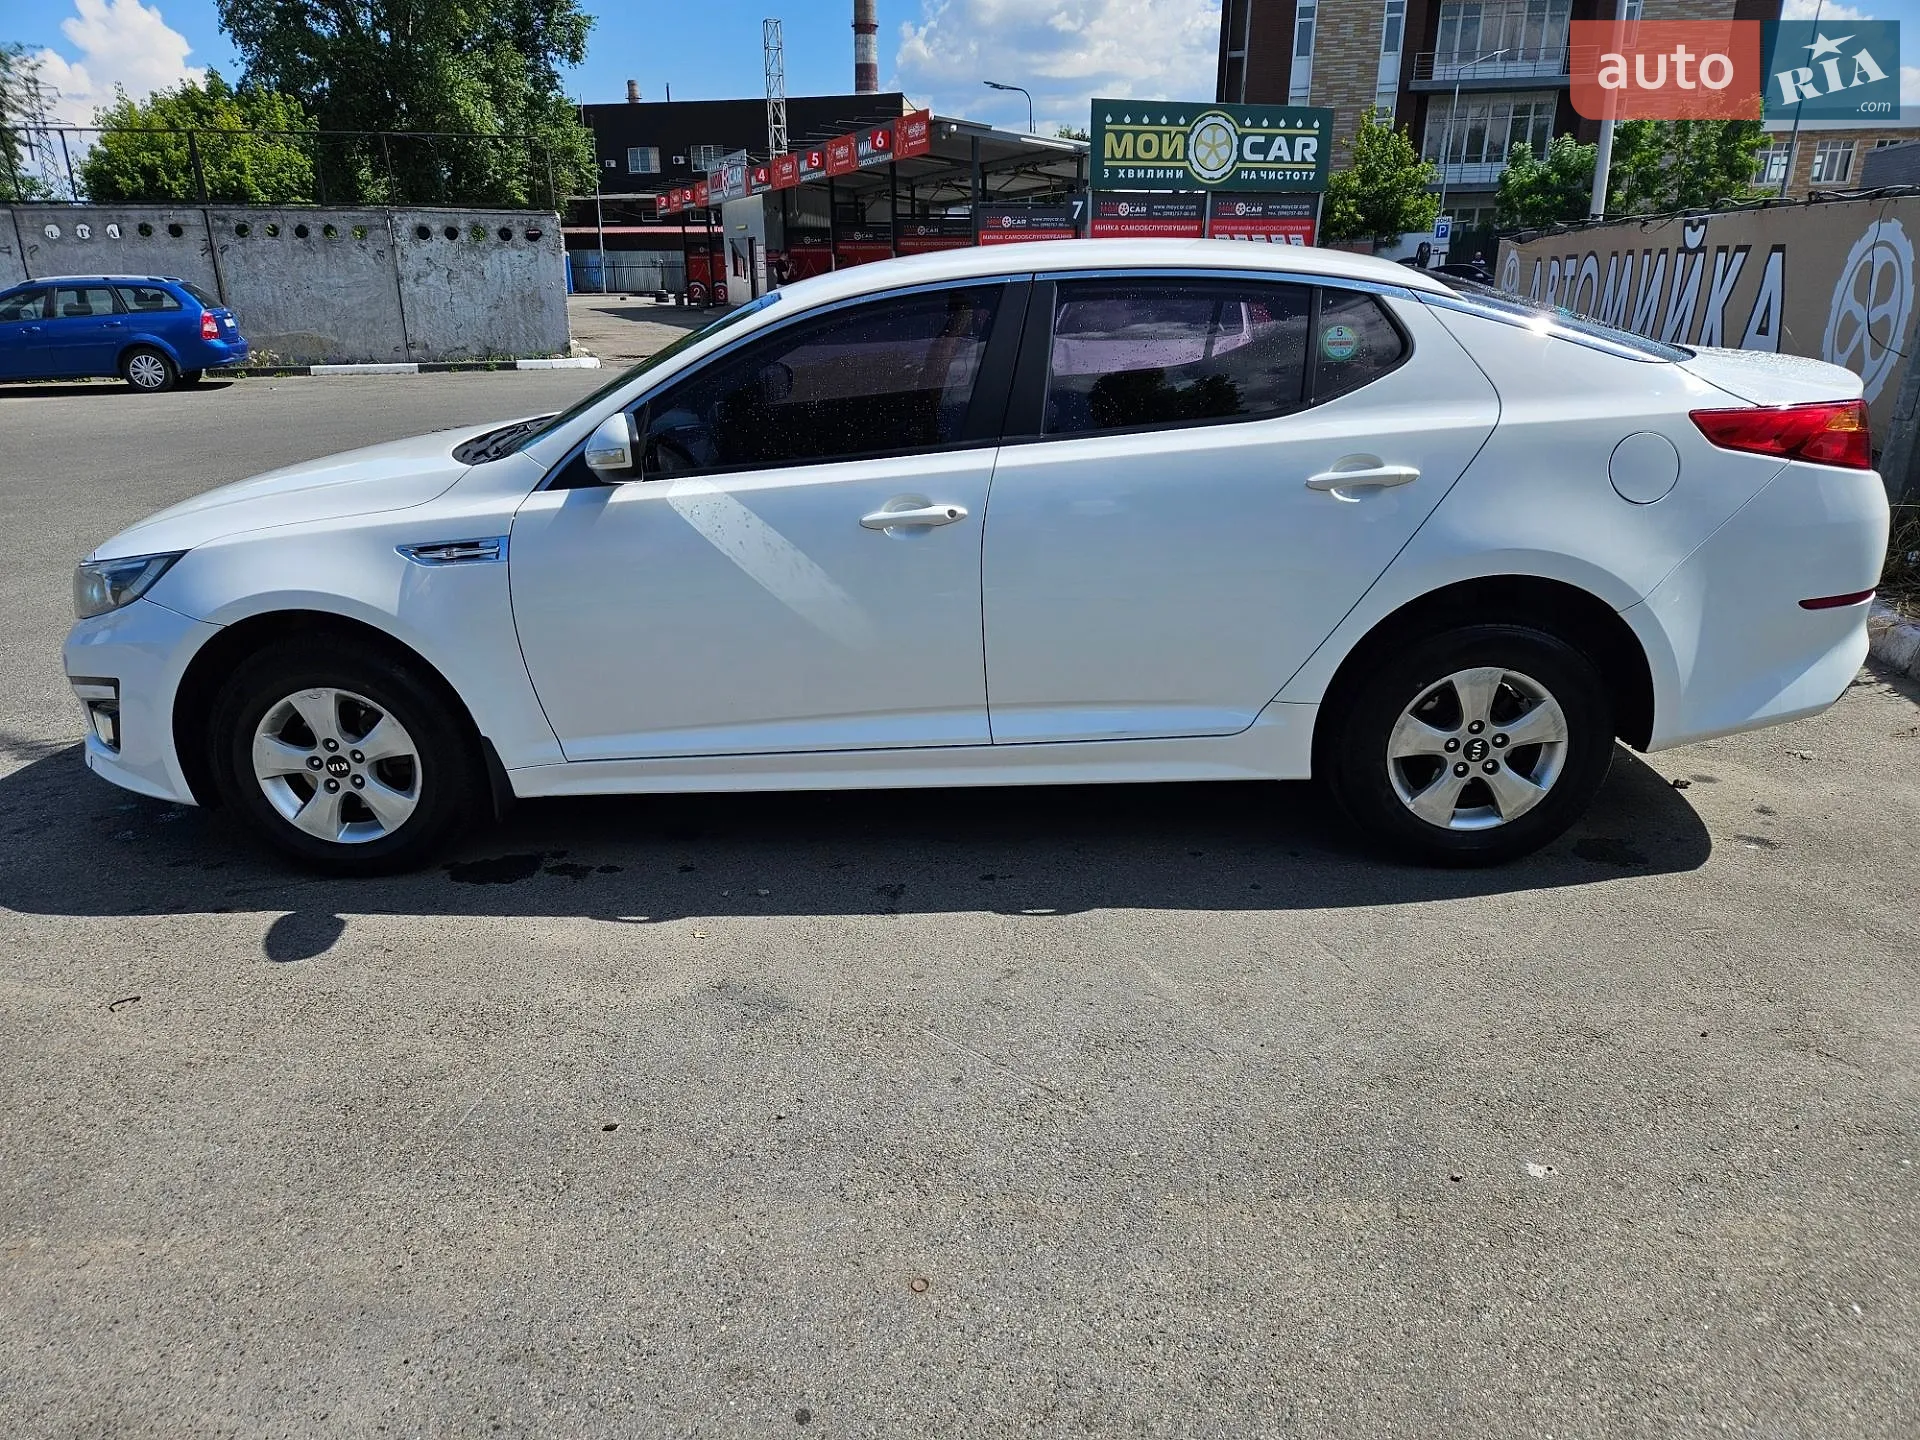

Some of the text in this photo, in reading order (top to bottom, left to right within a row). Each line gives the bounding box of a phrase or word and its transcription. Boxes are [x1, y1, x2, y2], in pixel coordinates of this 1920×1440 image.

[875, 131, 885, 148] 6
[1103, 128, 1319, 162] МОЙ CAR
[811, 152, 819, 167] 5
[758, 168, 766, 182] 4
[1118, 168, 1185, 179] ХВИЛИНИ
[1241, 170, 1258, 180] НА
[1260, 170, 1316, 181] ЧИСТОТУ
[660, 197, 666, 206] 2
[685, 190, 691, 200] 3
[1072, 201, 1084, 220] 7
[1439, 225, 1447, 237] P
[1529, 217, 1786, 354] АВТОМИЙКА
[693, 287, 701, 298] 2
[718, 288, 726, 300] 3
[1471, 740, 1483, 760] KIA
[327, 762, 349, 772] KIA
